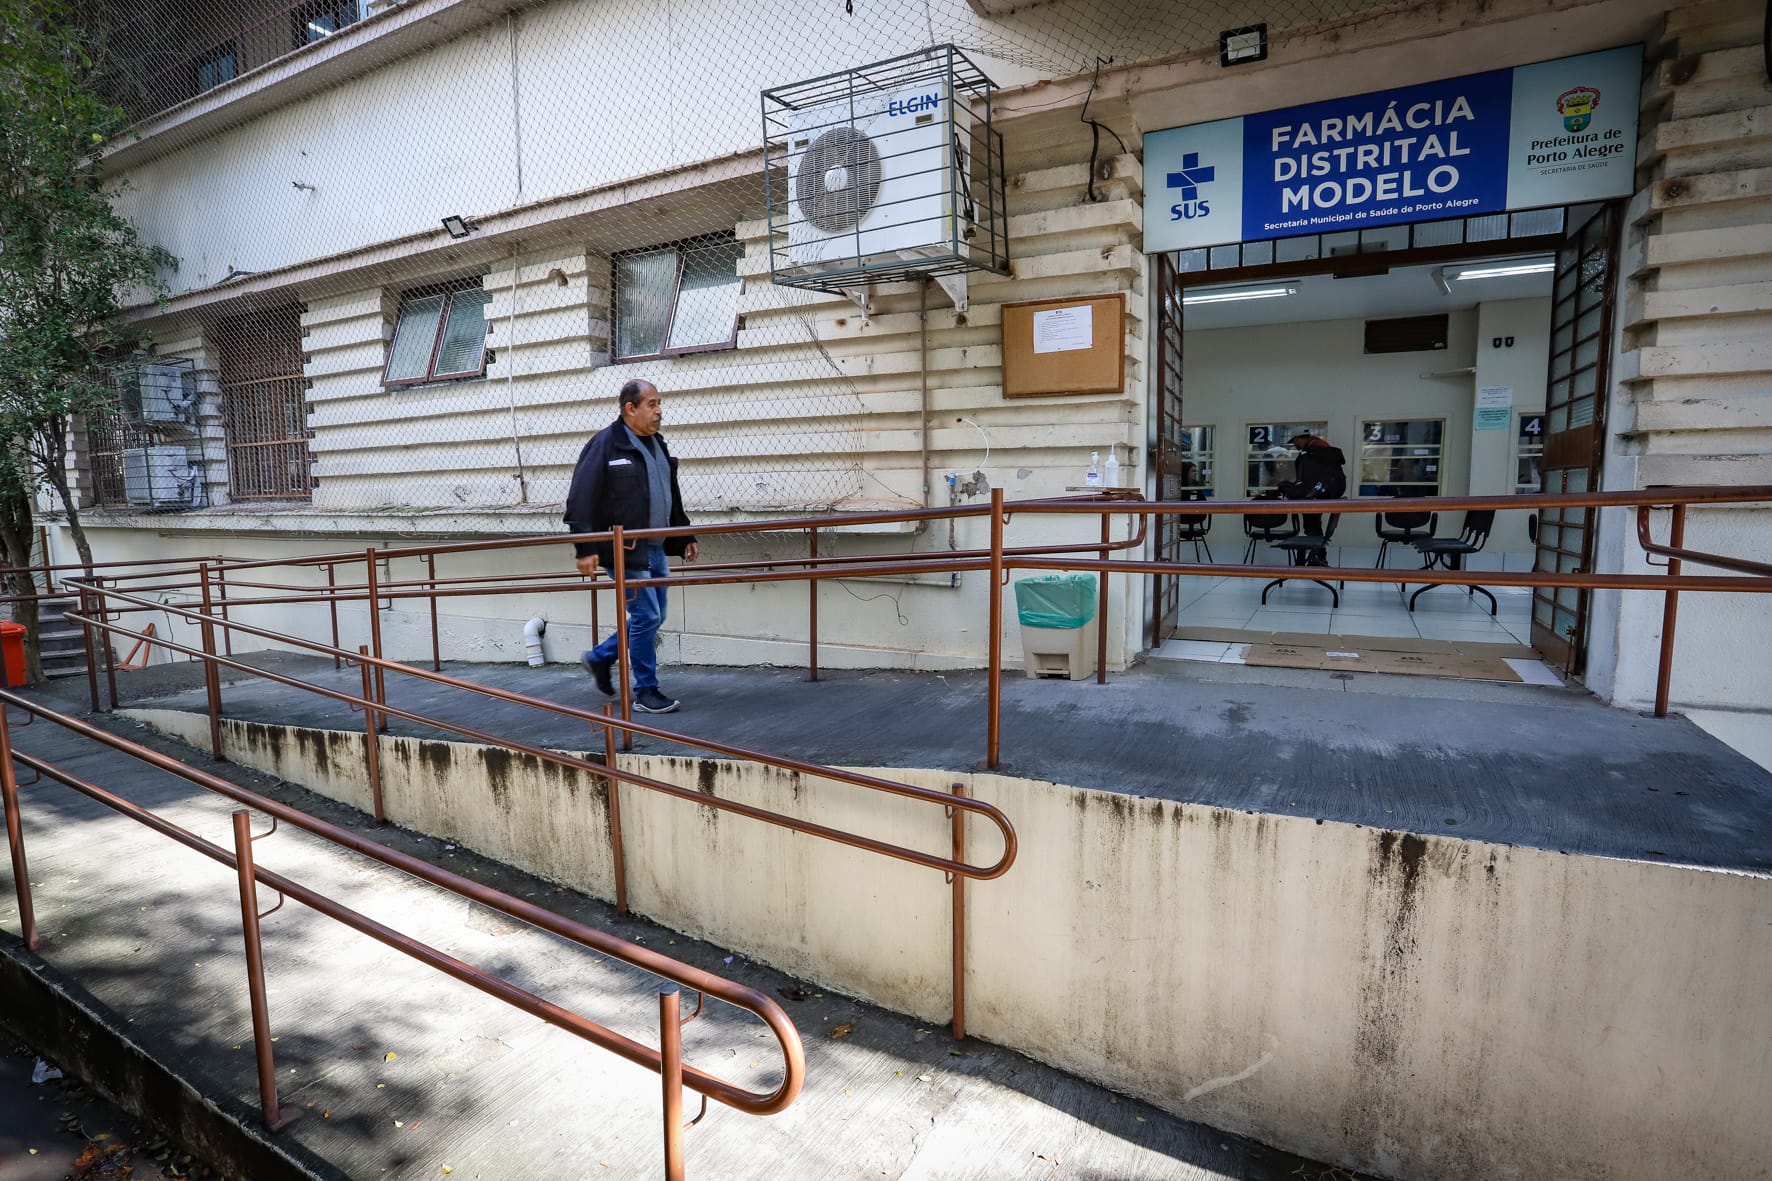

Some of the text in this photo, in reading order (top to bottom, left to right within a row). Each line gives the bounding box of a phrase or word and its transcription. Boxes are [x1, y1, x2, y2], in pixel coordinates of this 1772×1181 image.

[889, 92, 938, 117] ELGIN
[1271, 95, 1475, 152] FARMÁCIA
[1531, 128, 1622, 150] Prefeitura de
[1274, 131, 1471, 182] DISTRITAL
[1527, 142, 1624, 165] Porto Alegre
[1282, 165, 1460, 213] MODELO
[1171, 200, 1210, 221] SUS
[1264, 196, 1479, 230] Secretaria Municipal de Saúde de Porto Alegre
[1253, 428, 1267, 443] 2
[1370, 423, 1382, 441] 3
[1524, 417, 1541, 435] 4
